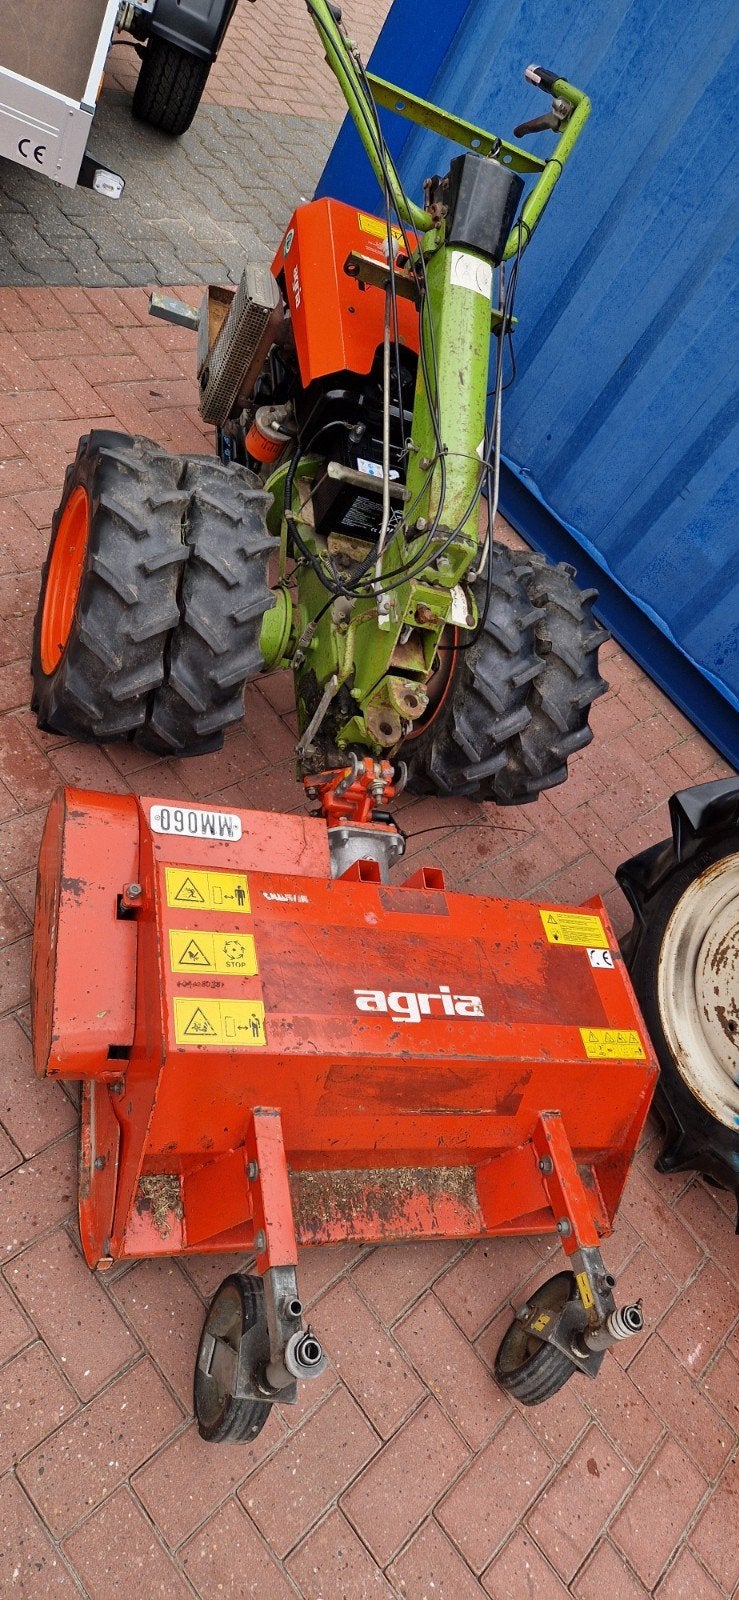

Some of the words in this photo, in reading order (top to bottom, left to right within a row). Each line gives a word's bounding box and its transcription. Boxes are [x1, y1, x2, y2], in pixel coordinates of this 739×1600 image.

[18, 139, 46, 165] CE
[160, 808, 234, 837] MM060
[354, 985, 485, 1023] agria
